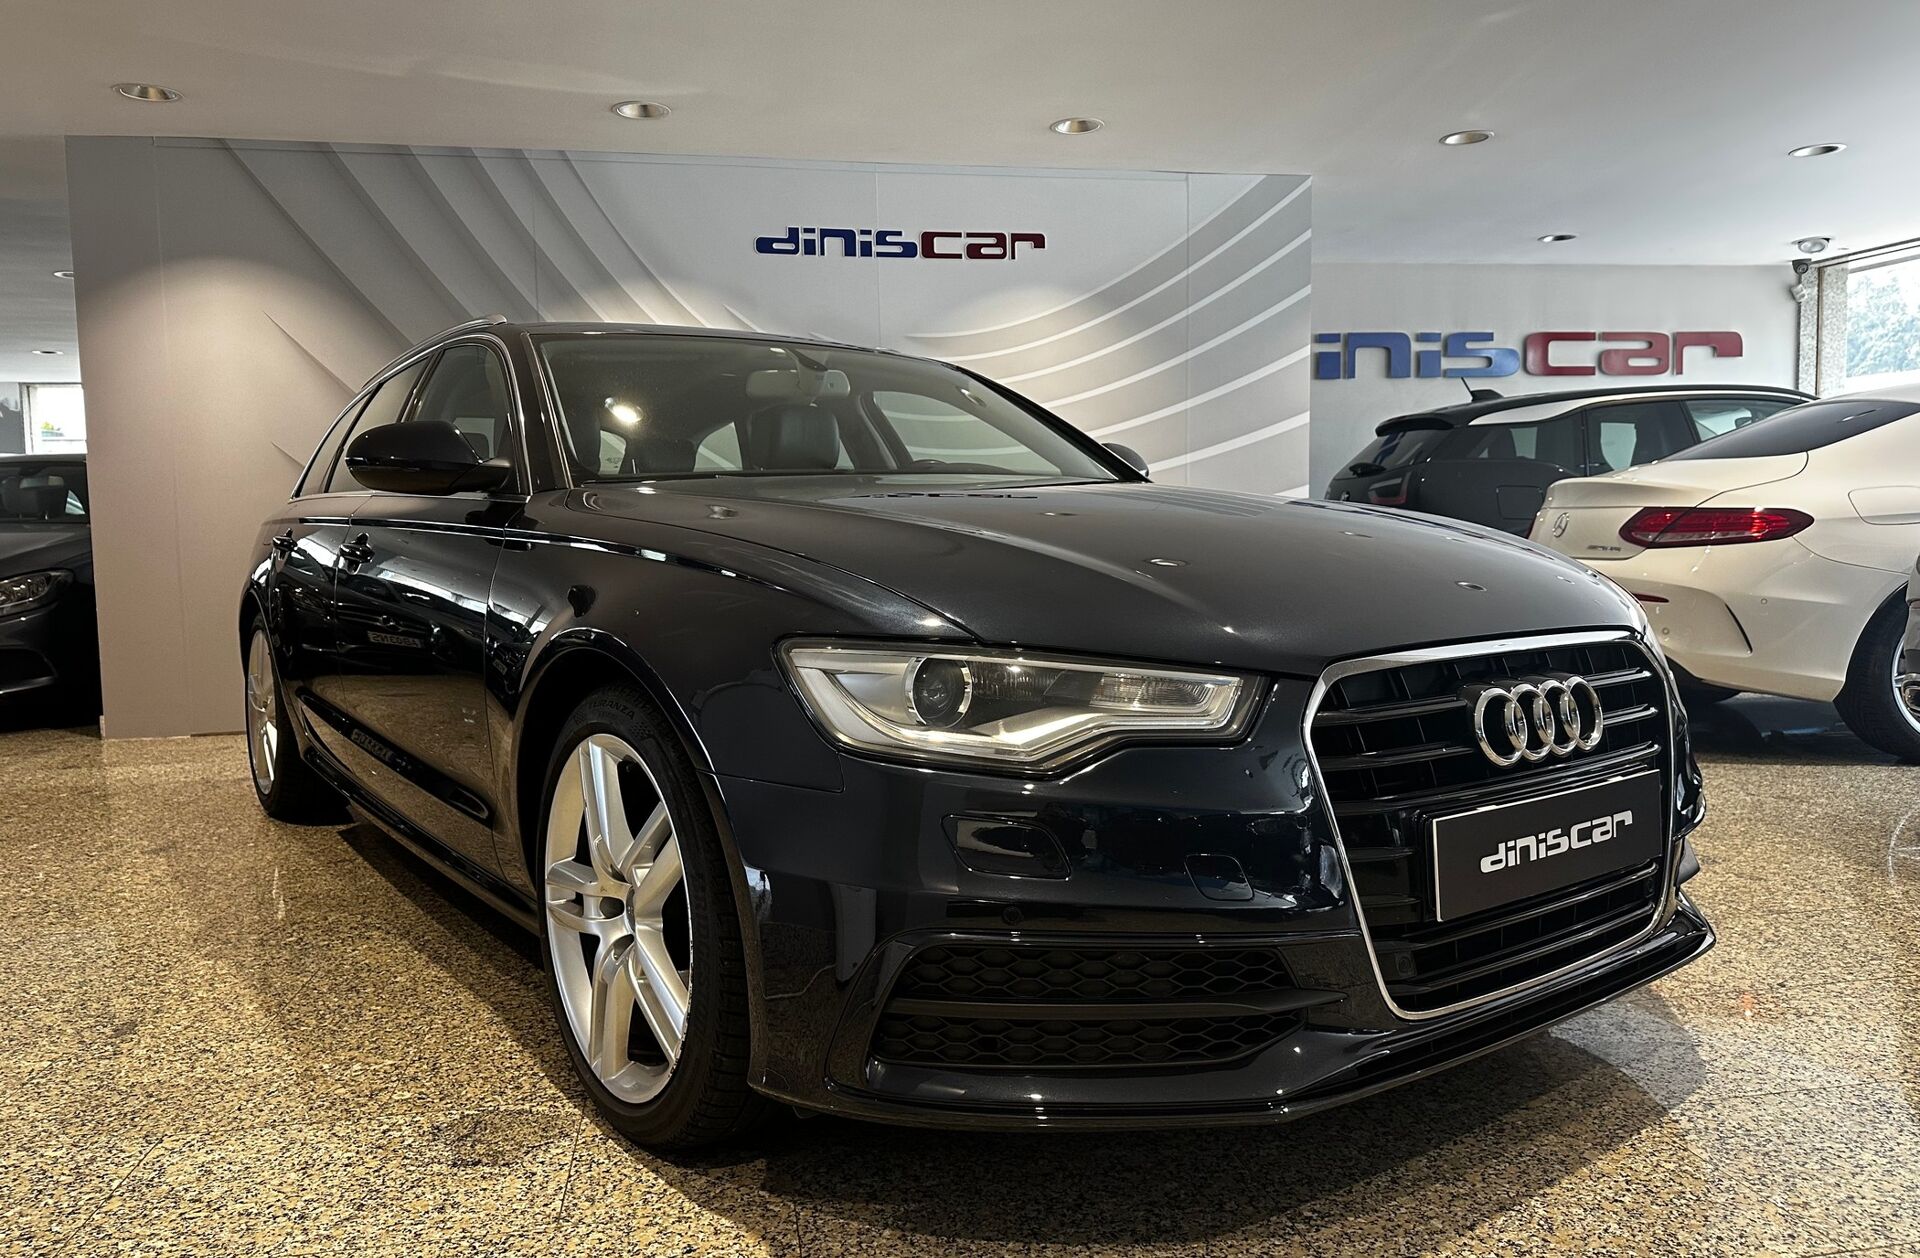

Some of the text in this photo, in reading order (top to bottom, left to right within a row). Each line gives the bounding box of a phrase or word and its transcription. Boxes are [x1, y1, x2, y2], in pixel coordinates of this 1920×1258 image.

[755, 226, 1046, 260] diniscar
[1314, 331, 1744, 380] iniscar
[1480, 810, 1633, 874] diniscar
